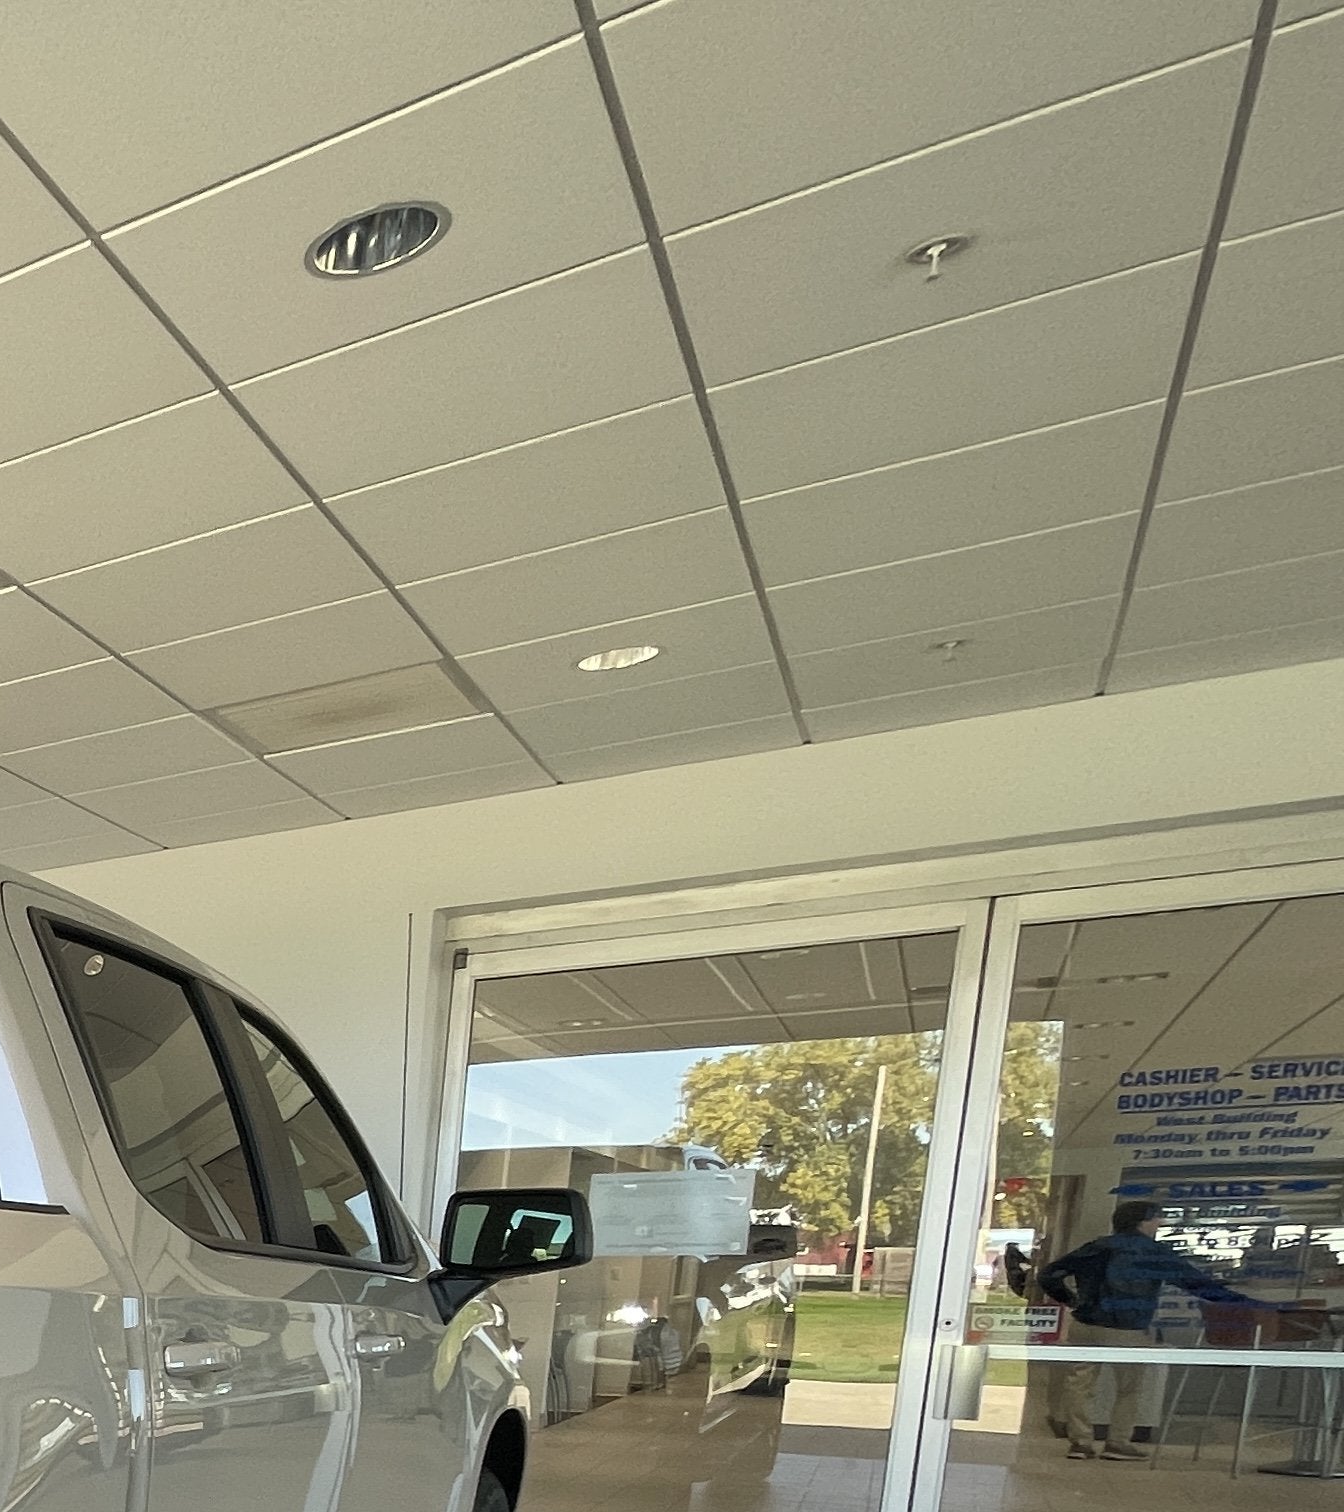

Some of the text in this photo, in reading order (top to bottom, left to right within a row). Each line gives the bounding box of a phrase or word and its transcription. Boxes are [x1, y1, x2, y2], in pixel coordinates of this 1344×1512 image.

[1119, 1066, 1220, 1087] CASHIER
[1116, 1088, 1244, 1110] BODYSHOP
[1156, 1111, 1299, 1127] West Building
[1113, 1126, 1332, 1145] Monday thru Friday
[1132, 1144, 1316, 1161] 7:30am to 5:00pm
[1168, 1181, 1265, 1199] SALES
[1000, 1319, 1056, 1328] FACILITY
